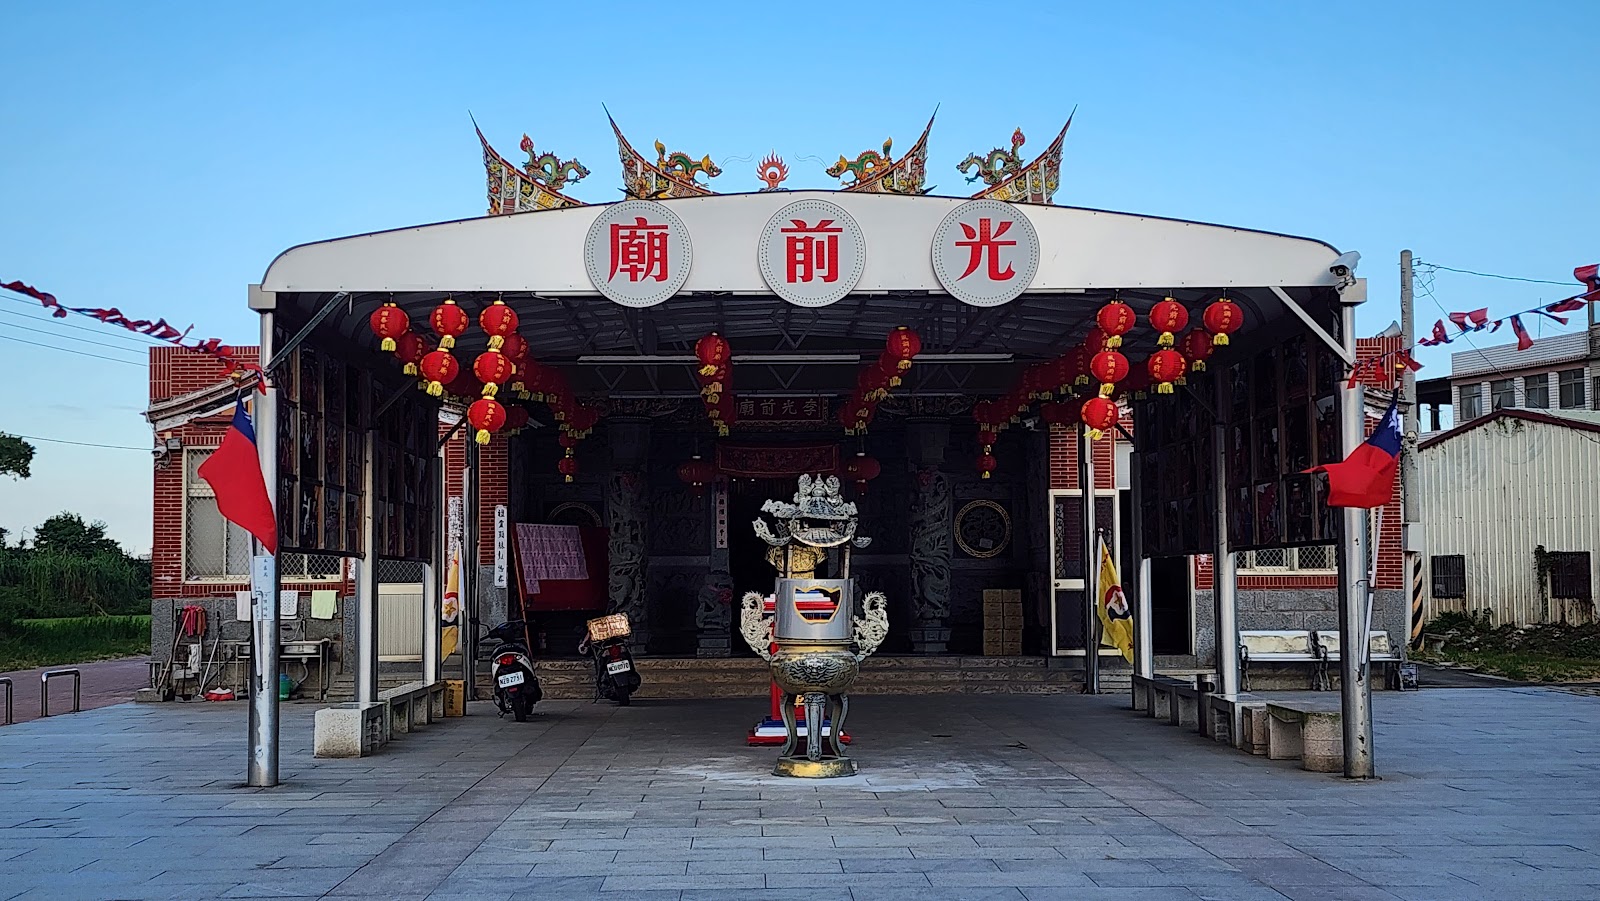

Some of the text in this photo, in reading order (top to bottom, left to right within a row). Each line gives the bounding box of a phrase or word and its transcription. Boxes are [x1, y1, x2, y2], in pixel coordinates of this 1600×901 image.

[607, 217, 1017, 284] 光前廟
[738, 397, 819, 417] 李光前廟
